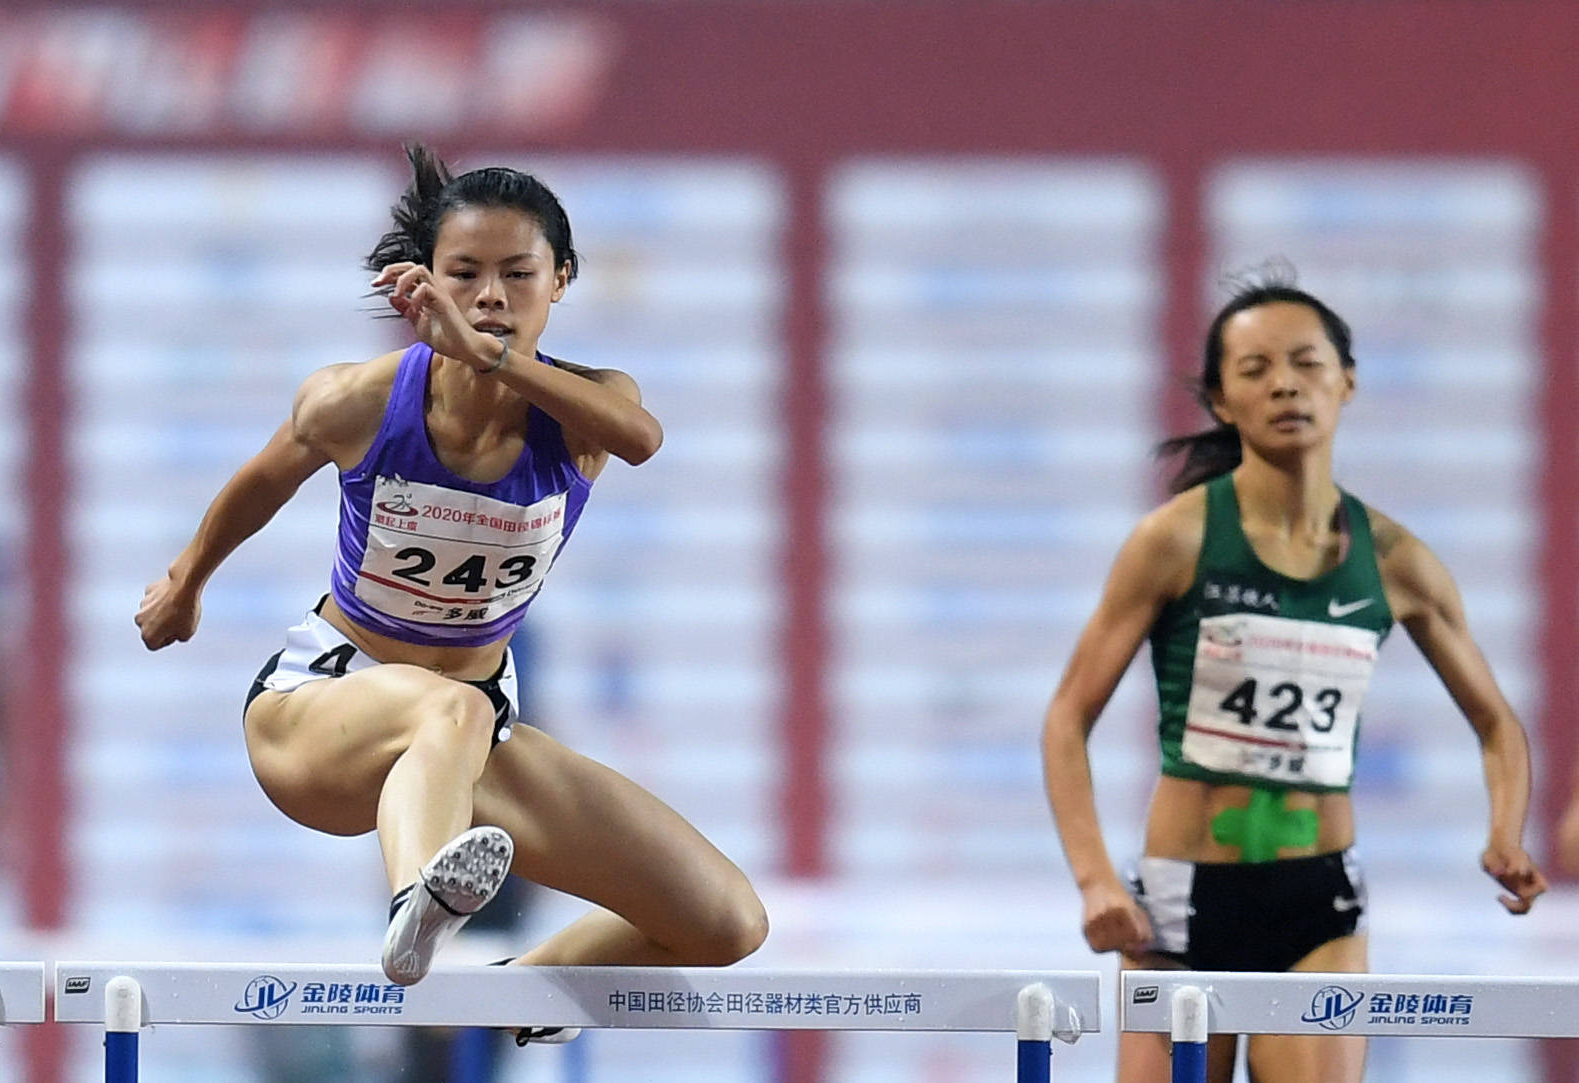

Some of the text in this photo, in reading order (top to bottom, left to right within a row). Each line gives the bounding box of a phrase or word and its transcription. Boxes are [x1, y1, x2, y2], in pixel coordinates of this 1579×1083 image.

[391, 547, 537, 593] 243
[309, 642, 358, 677] 4
[1221, 677, 1342, 733] 423
[301, 982, 406, 1004] 金陵体育
[608, 990, 923, 1016] 中国田径协会田径器材类官方供应商
[1367, 992, 1474, 1015] 金陵体育
[300, 1005, 403, 1015] JINLING SPORTS
[1367, 1015, 1470, 1025] JINLING SPORTS
